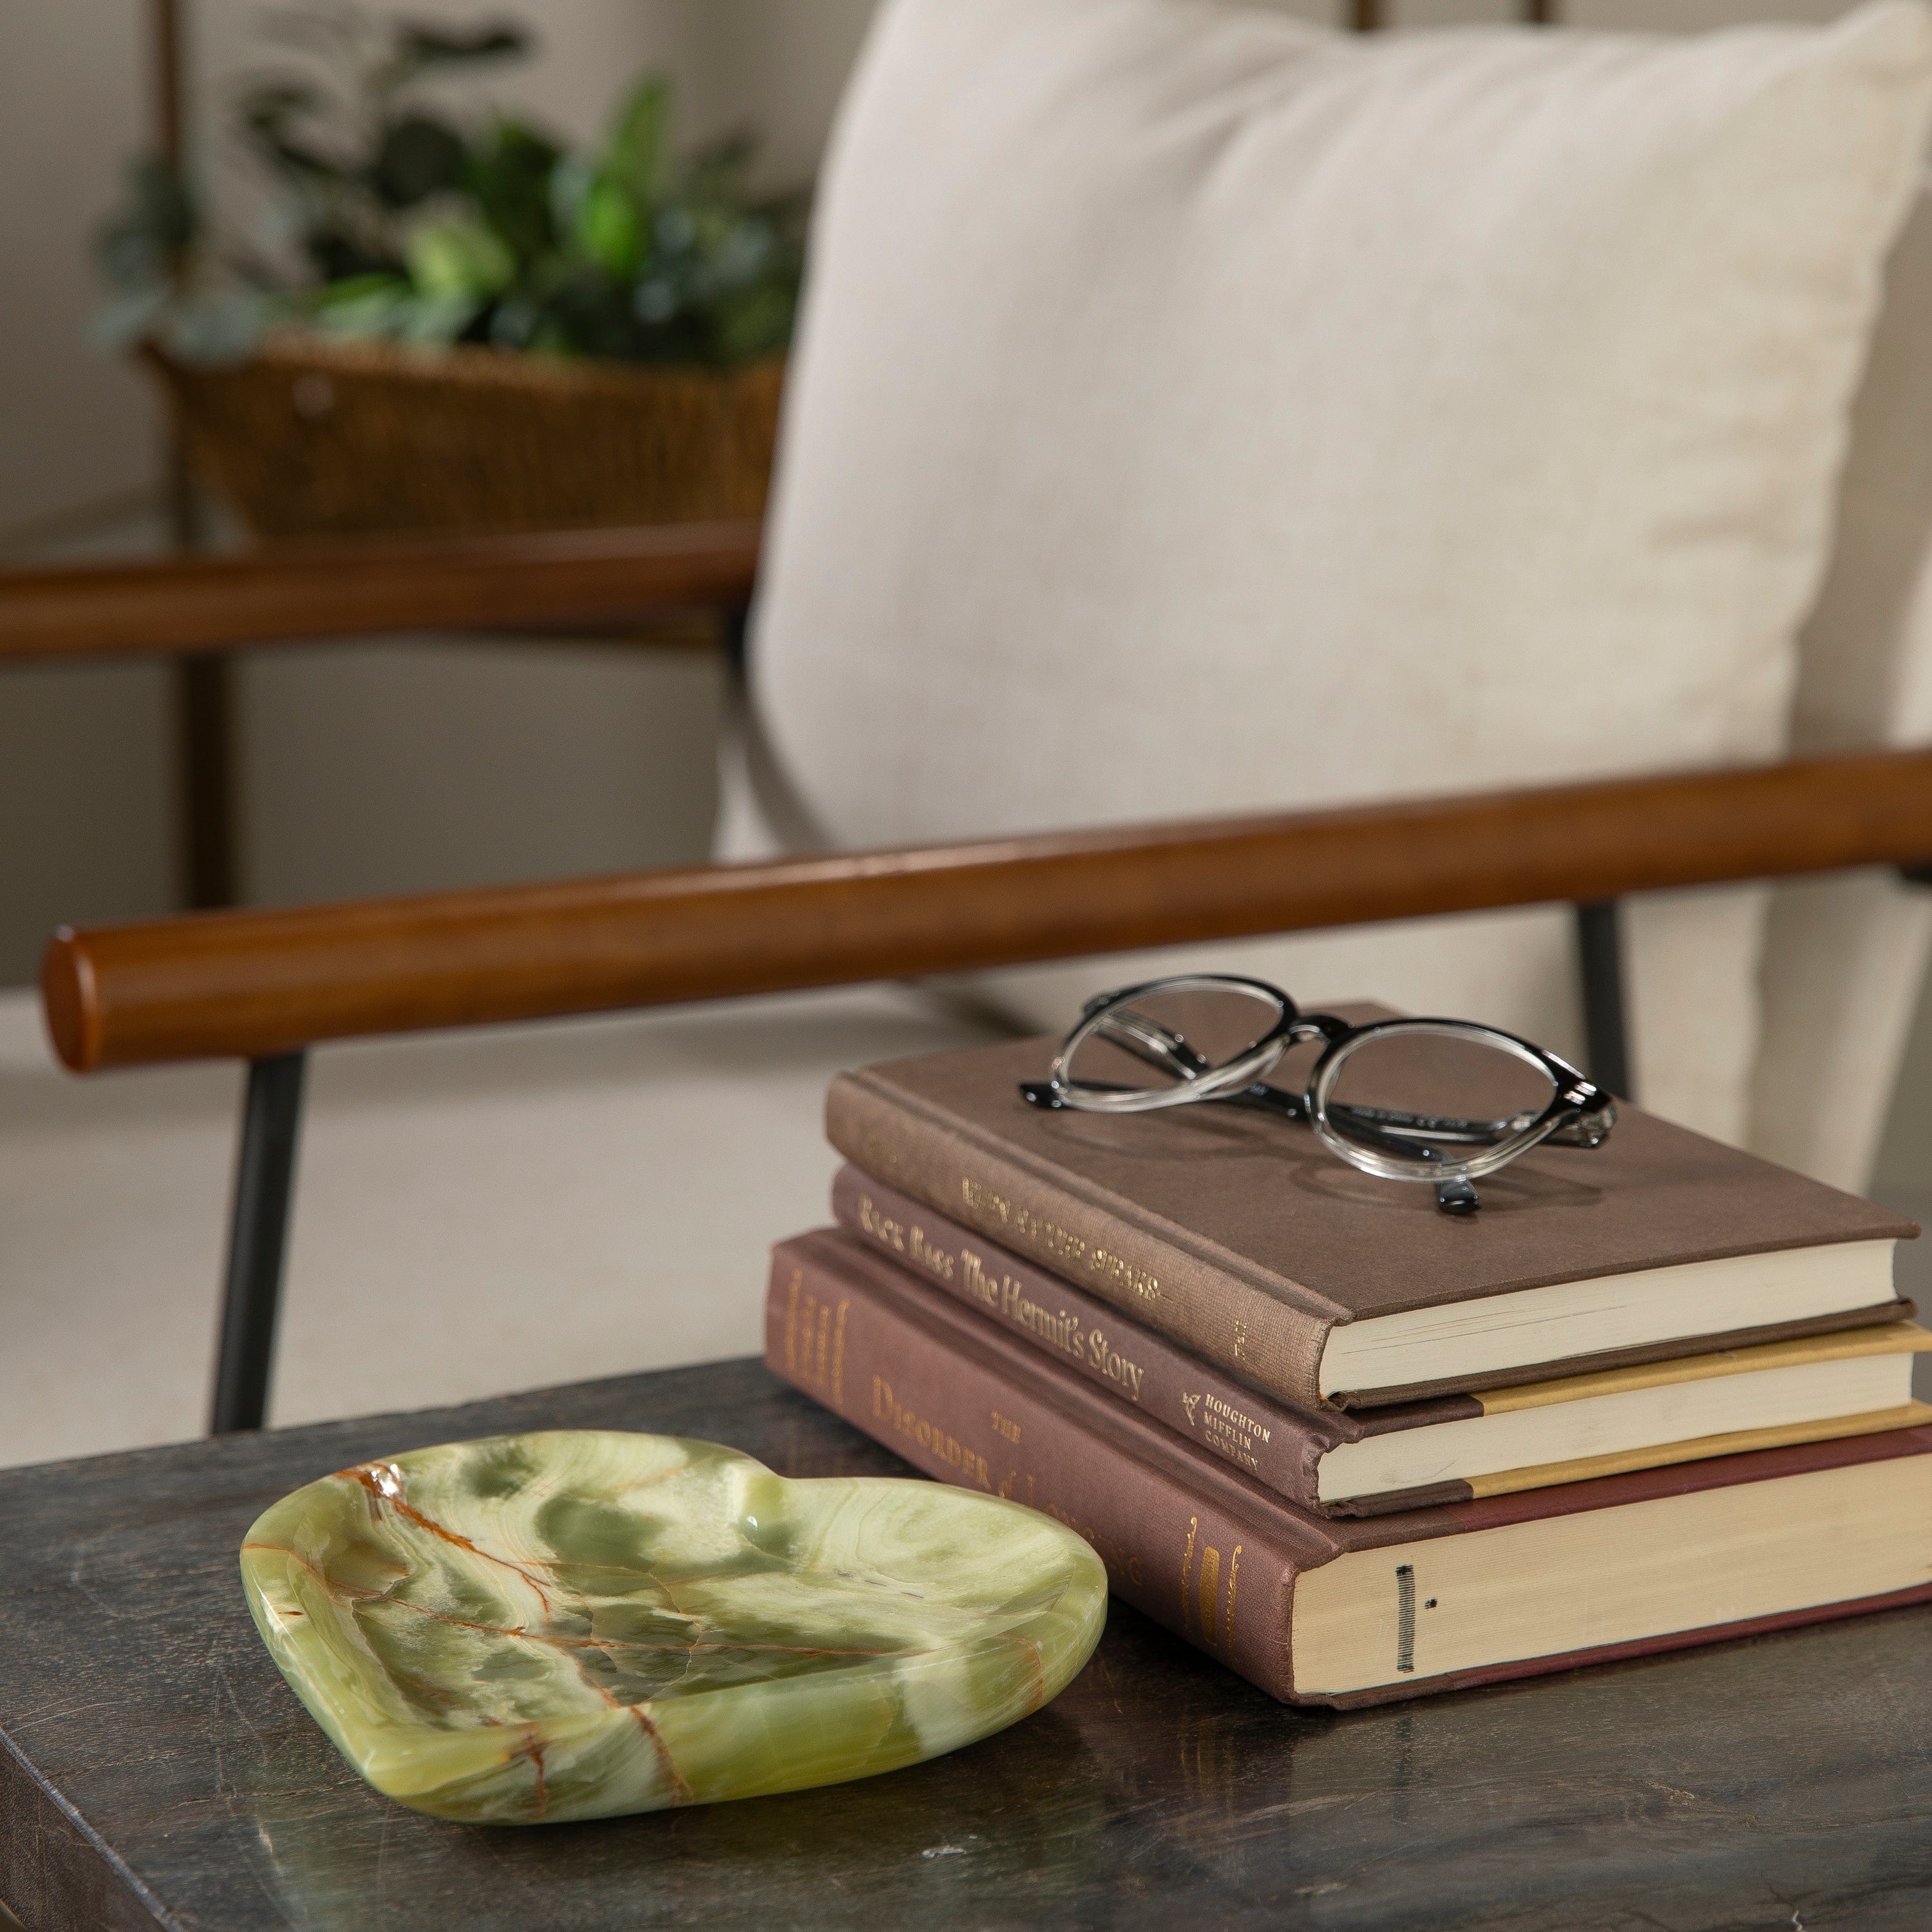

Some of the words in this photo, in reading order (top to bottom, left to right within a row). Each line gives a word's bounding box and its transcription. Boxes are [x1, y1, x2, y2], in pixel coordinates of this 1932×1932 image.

[961, 1249, 998, 1307] The
[1001, 1274, 1084, 1359] Hermit's
[1088, 1329, 1144, 1401] Story
[1204, 1411, 1251, 1450] MIFFLIN
[1205, 1394, 1271, 1443] HOUGHTON
[1205, 1430, 1258, 1470] COMPANY
